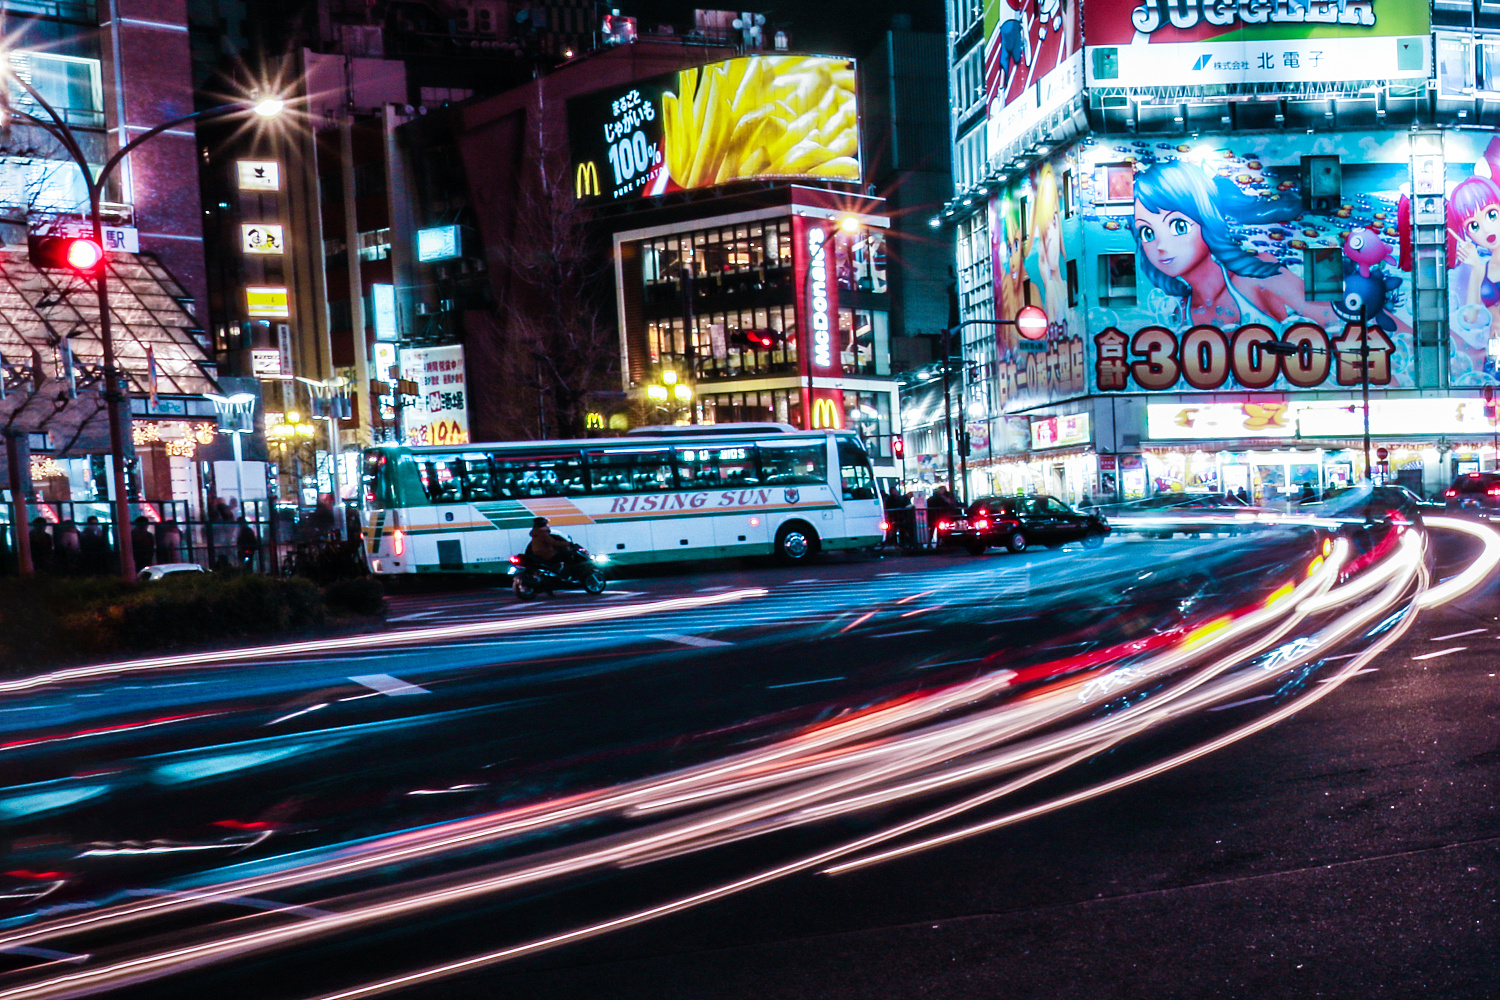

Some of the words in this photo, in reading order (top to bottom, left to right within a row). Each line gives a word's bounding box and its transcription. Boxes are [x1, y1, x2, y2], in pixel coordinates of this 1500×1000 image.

[1214, 61, 1249, 70] 株式会社
[1257, 51, 1325, 70] 北電子
[612, 89, 641, 116] まるごと
[604, 101, 655, 142] じゃがいも
[609, 131, 661, 185] 100%
[614, 183, 633, 198] PURE
[610, 492, 708, 514] RISING
[718, 488, 772, 506] SUN
